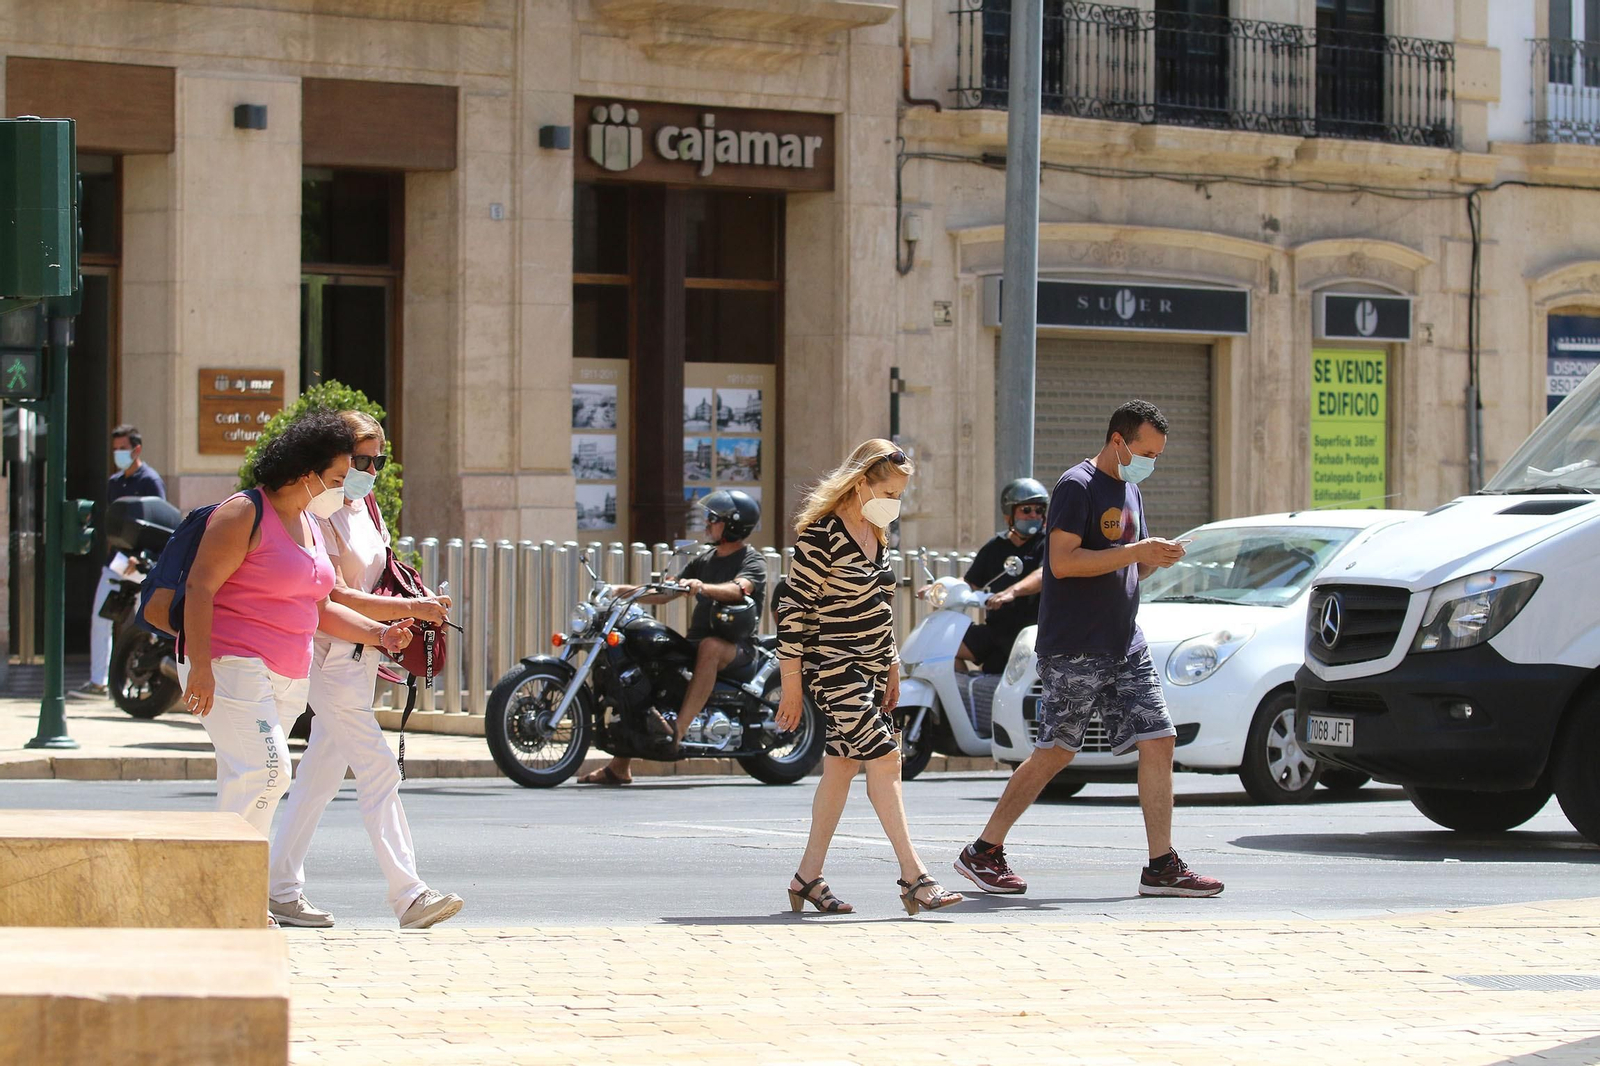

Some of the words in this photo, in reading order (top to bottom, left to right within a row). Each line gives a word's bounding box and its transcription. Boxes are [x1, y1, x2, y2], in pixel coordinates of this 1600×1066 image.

[655, 113, 823, 177] cajamar
[1077, 289, 1173, 320] SUPER
[1314, 359, 1332, 383] SE
[1336, 359, 1384, 385] VENDE
[1553, 361, 1597, 375] DISPONI
[230, 378, 274, 393] ajmar
[1550, 378, 1571, 393] 950
[1318, 391, 1379, 417] EDIFICIO
[215, 412, 251, 424] cento
[256, 411, 271, 424] de
[1314, 434, 1352, 449] Superficie
[1314, 452, 1344, 465] Fachada
[1345, 452, 1380, 468] Protegida
[1314, 470, 1355, 486] Catalogada
[1356, 471, 1377, 483] Grado
[1104, 520, 1120, 529] SPR
[1311, 719, 1329, 741] 7068
[1332, 721, 1351, 743] JFT
